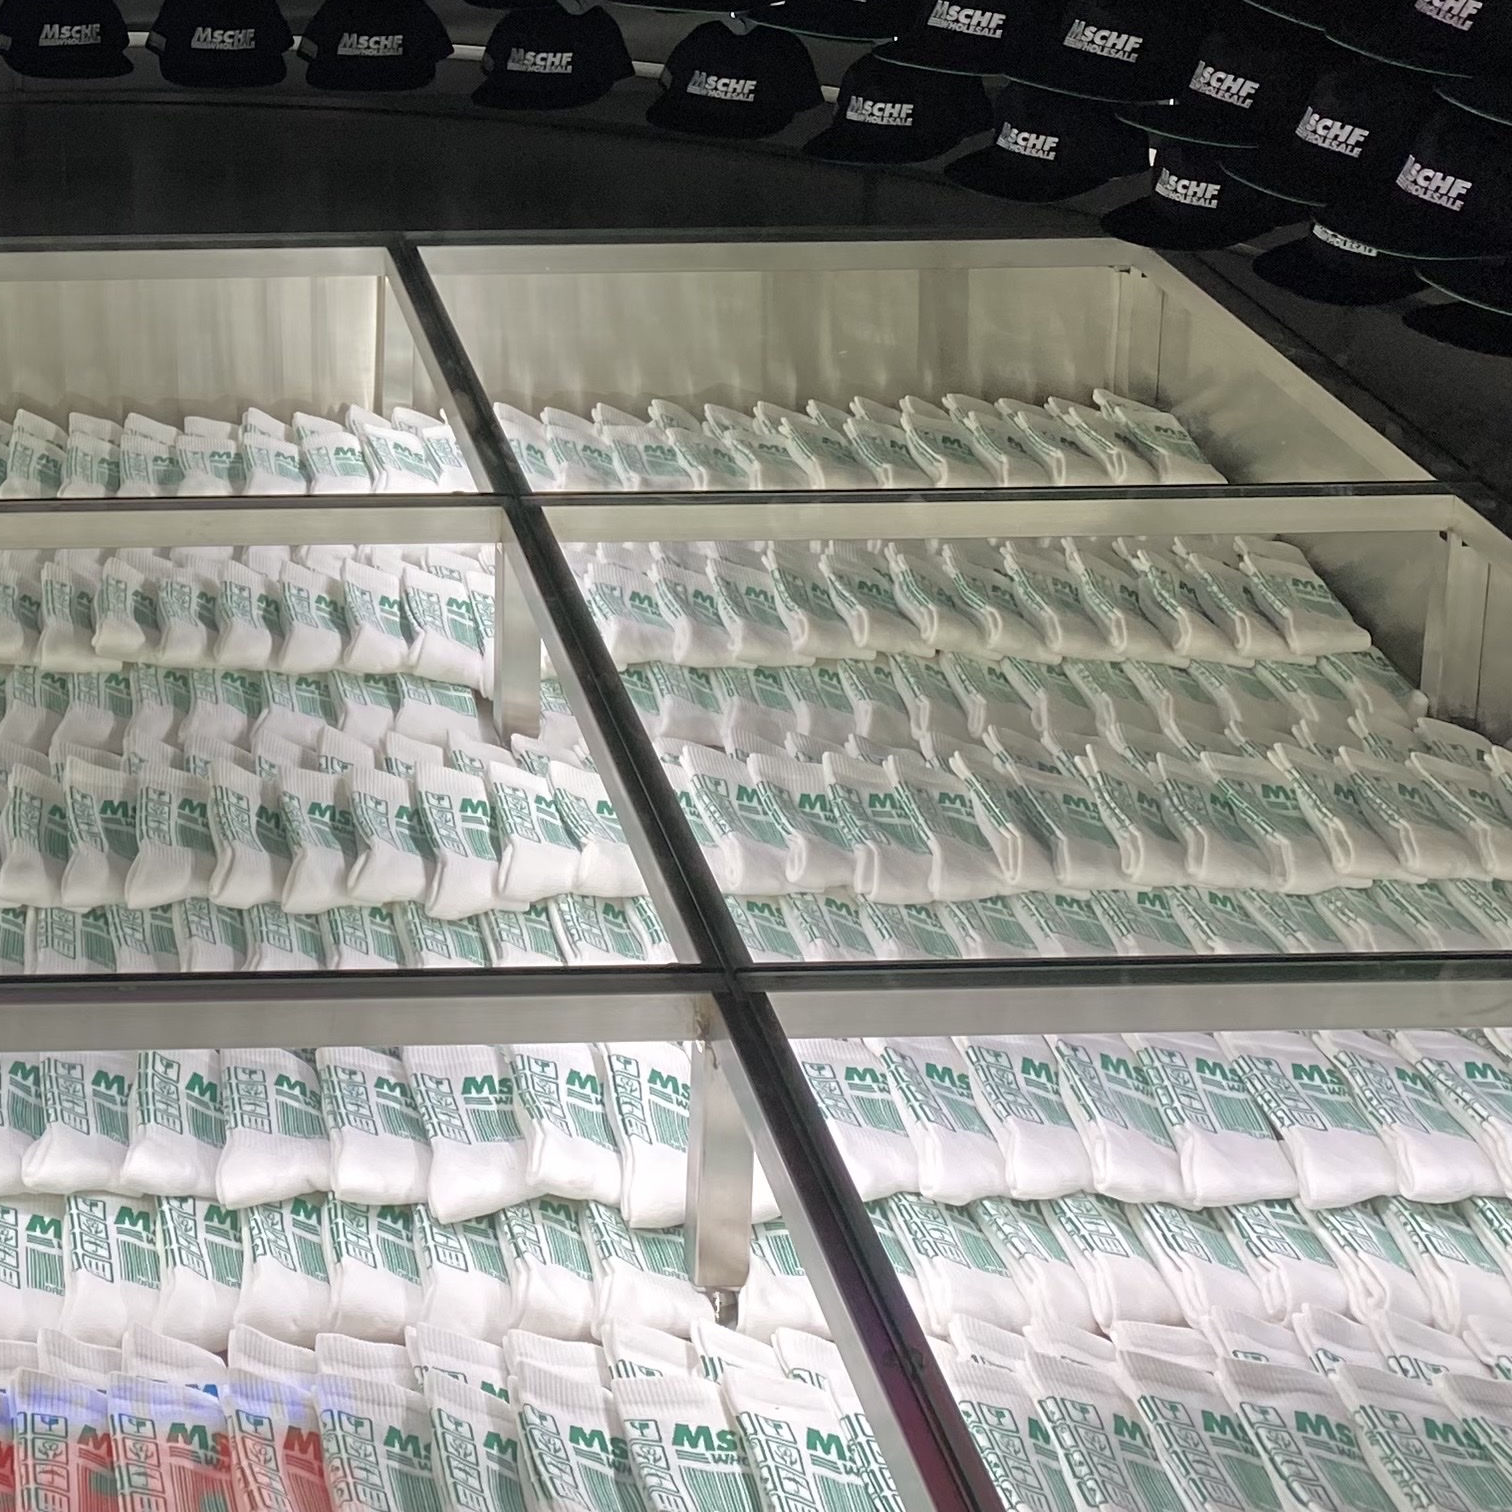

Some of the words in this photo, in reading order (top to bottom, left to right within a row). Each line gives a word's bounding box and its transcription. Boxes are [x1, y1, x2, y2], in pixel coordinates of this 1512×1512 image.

[929, 0, 1006, 28] MSCHF
[192, 27, 255, 44] MSCHF
[339, 33, 403, 49] MSCHF
[1063, 19, 1143, 54] MSCHF
[509, 48, 573, 65] MSCHF
[688, 70, 757, 93] MSCHF
[847, 96, 914, 117] MSCHF
